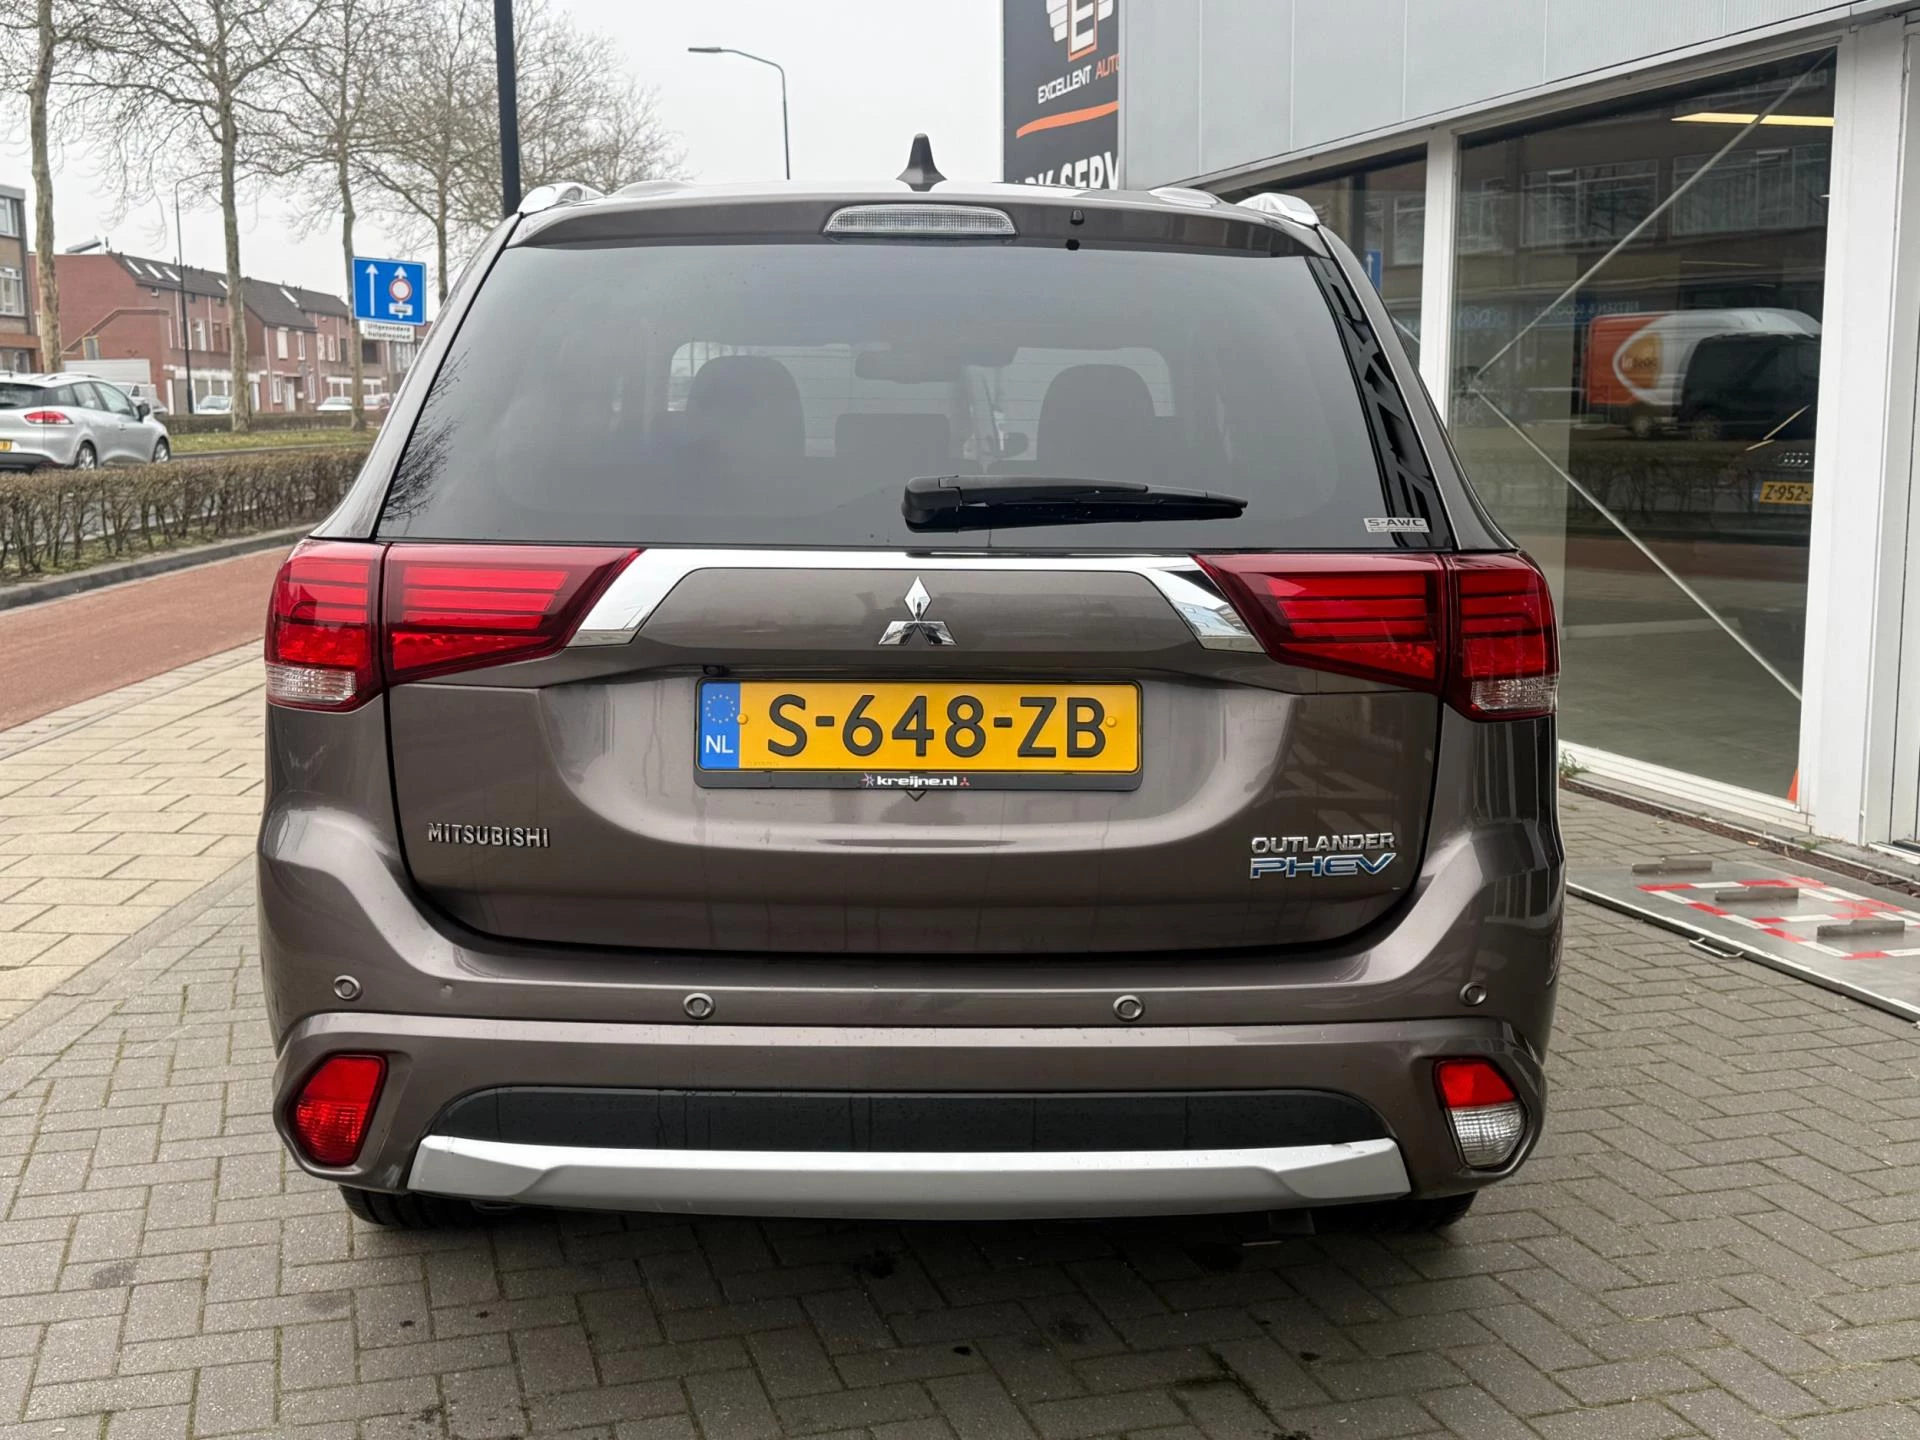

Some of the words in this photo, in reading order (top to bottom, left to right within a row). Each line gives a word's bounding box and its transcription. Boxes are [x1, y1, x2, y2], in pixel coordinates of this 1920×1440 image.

[1038, 65, 1092, 104] EXCELLENT
[1763, 484, 1812, 501] Z-952-
[1368, 519, 1425, 527] S-AWC
[767, 693, 1107, 758] S-648-ZB
[705, 734, 734, 754] NL
[876, 775, 958, 788] kreijne.nl
[428, 822, 550, 848] MITSUBISHI
[1251, 832, 1396, 854] OUTLANDER
[1250, 852, 1397, 879] PHEV
